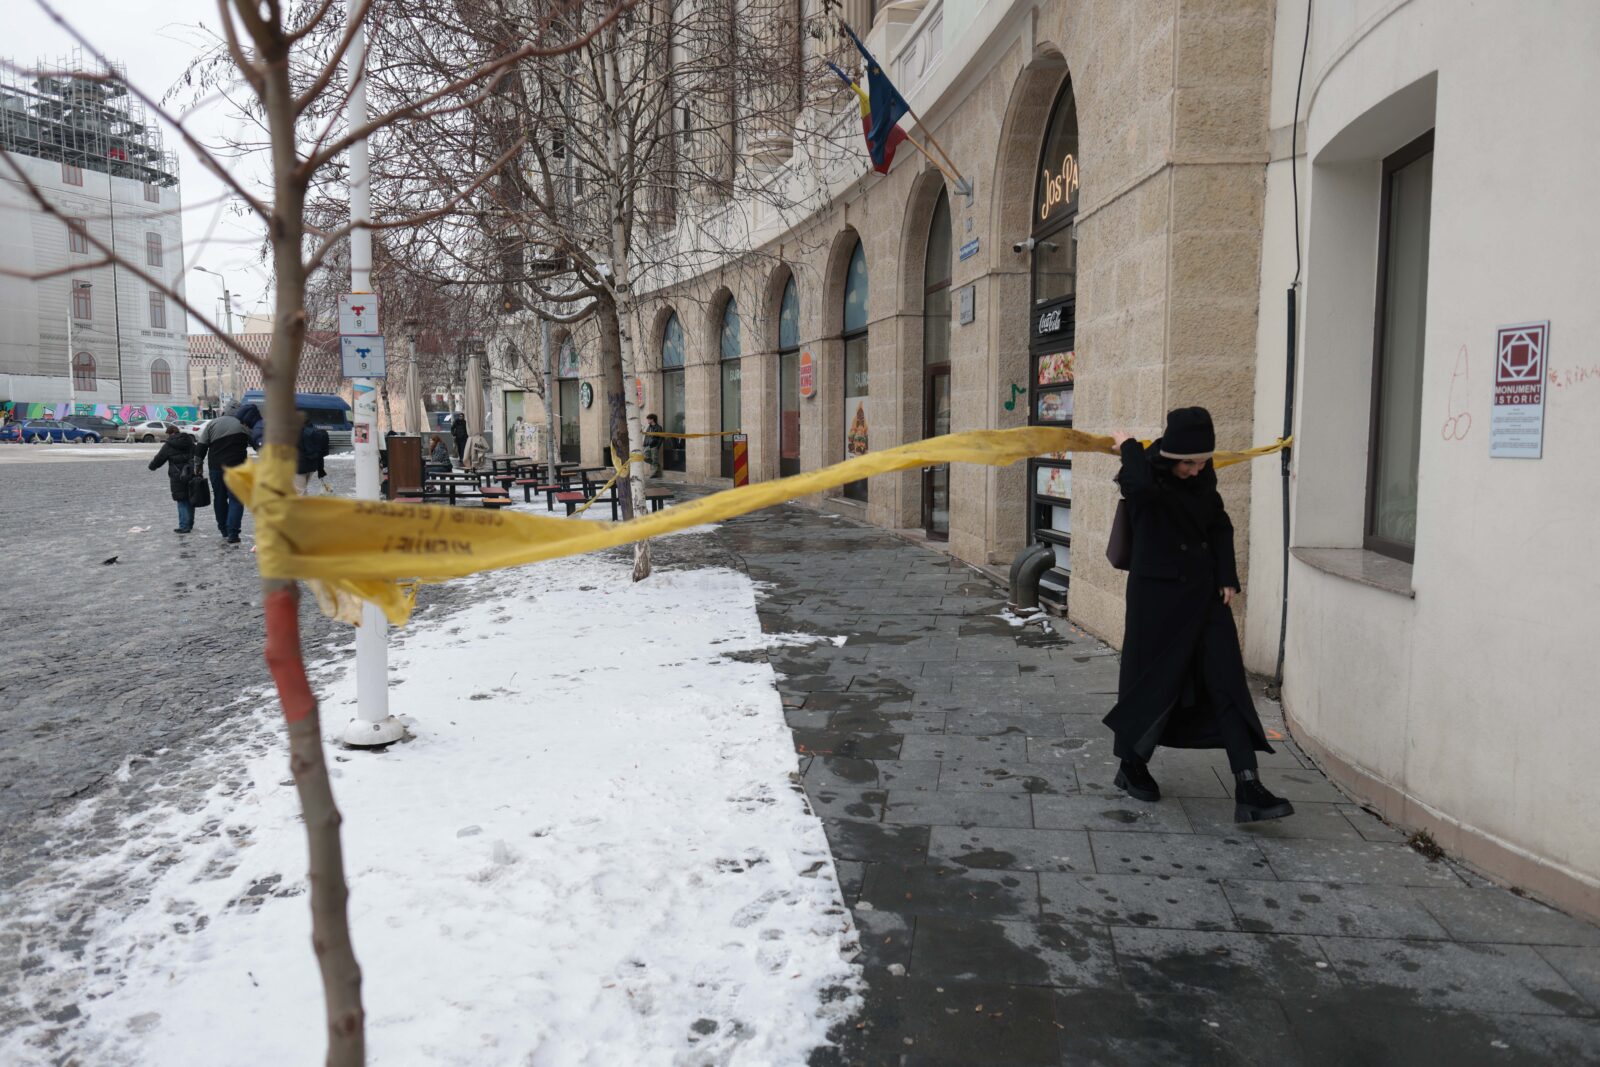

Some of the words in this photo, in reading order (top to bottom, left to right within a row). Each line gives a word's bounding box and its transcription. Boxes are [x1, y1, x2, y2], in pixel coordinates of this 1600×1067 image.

[1039, 310, 1061, 334] Coca-Cola
[1495, 384, 1541, 394] MONUMENT
[1495, 394, 1540, 404] ISTORIC
